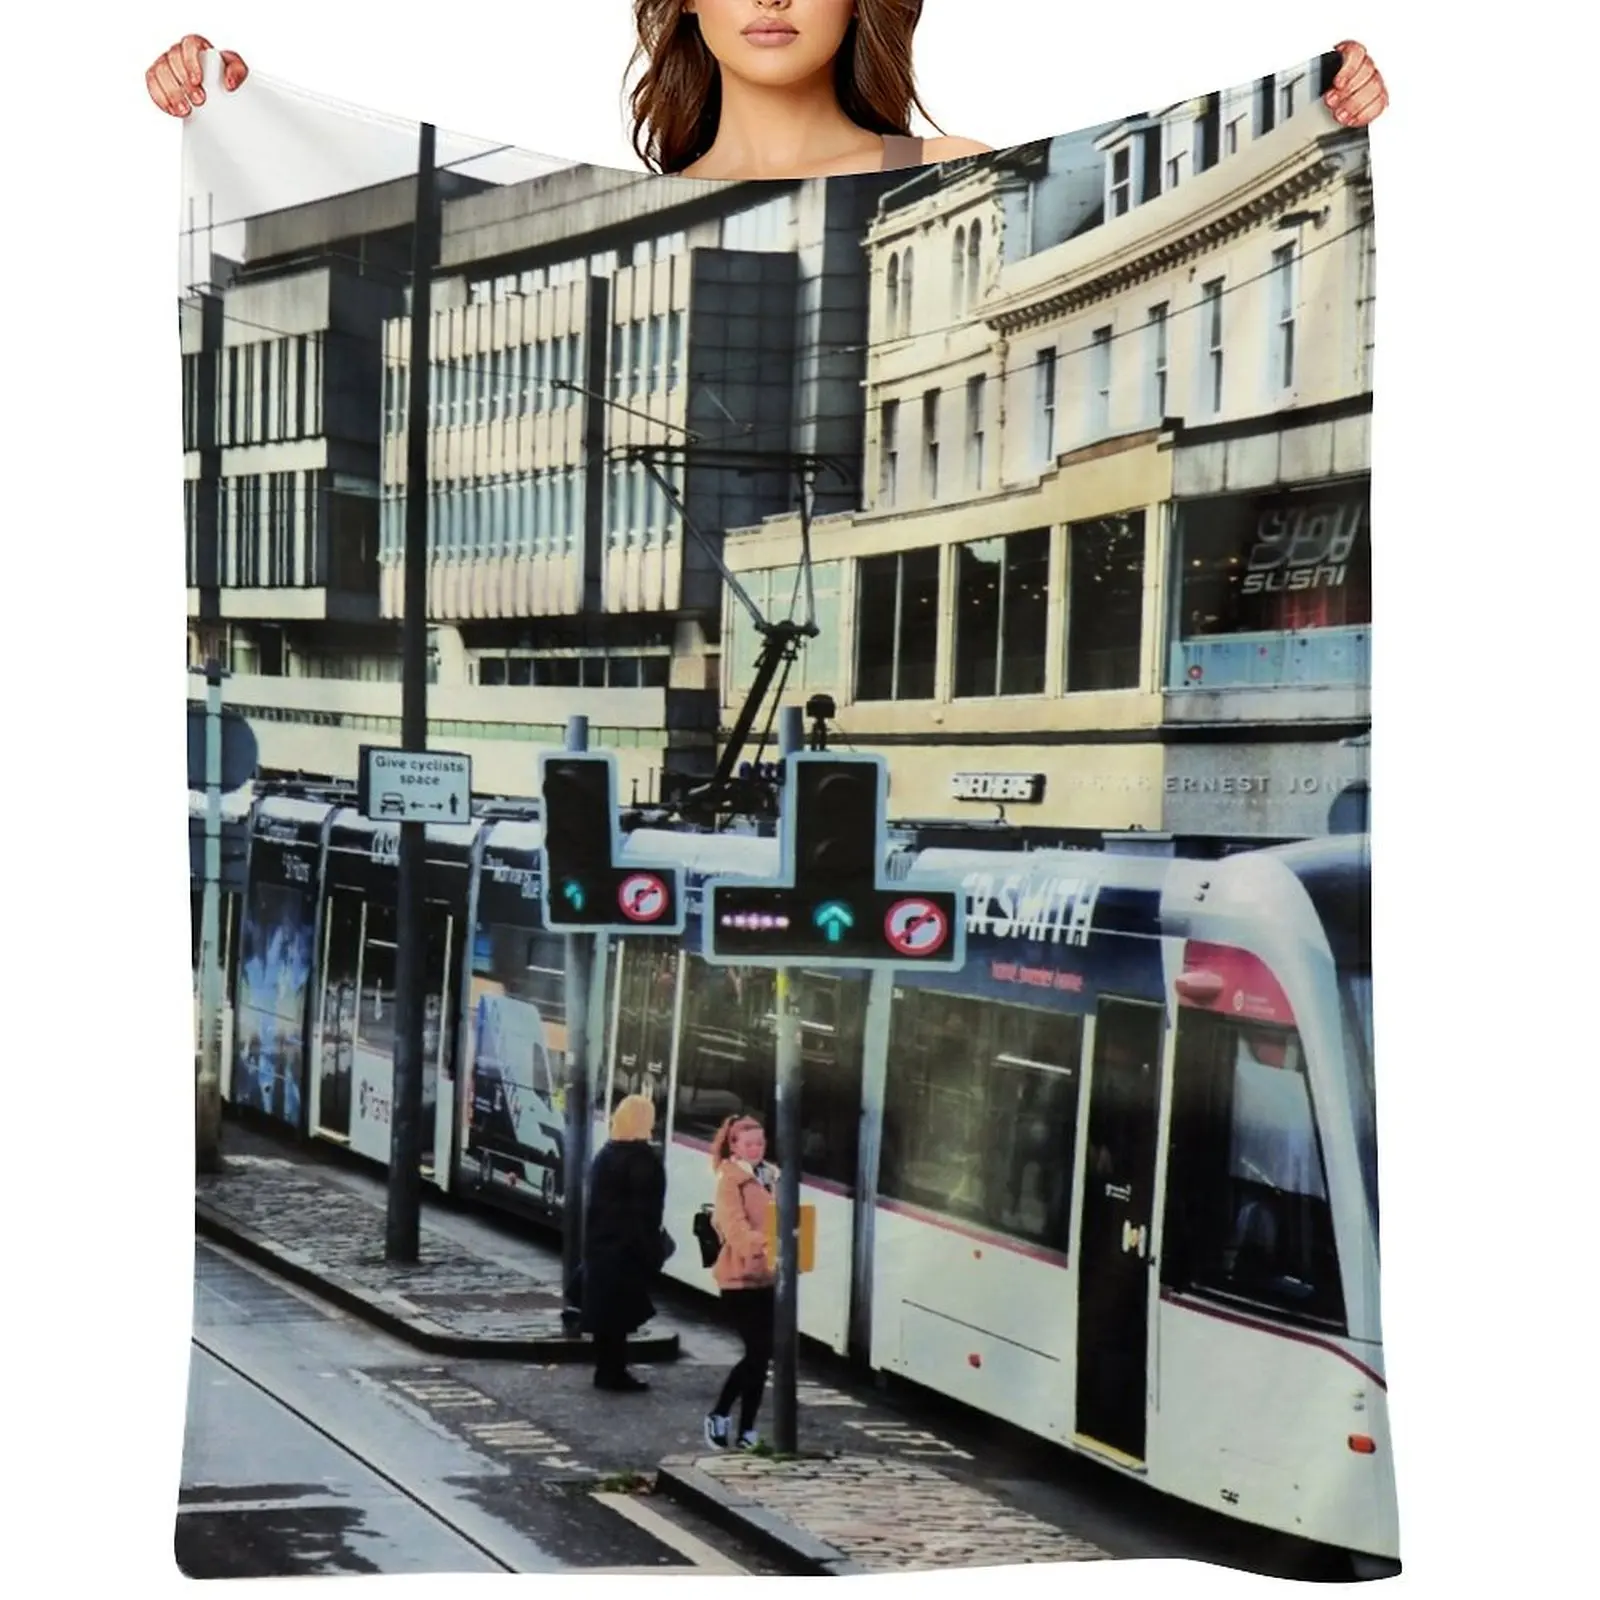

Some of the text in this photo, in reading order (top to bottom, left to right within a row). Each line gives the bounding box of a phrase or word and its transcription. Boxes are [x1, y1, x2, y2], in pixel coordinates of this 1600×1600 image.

[375, 756, 464, 773] Give cyclists
[400, 775, 440, 786] space
[1165, 777, 1269, 794] ERNEST
